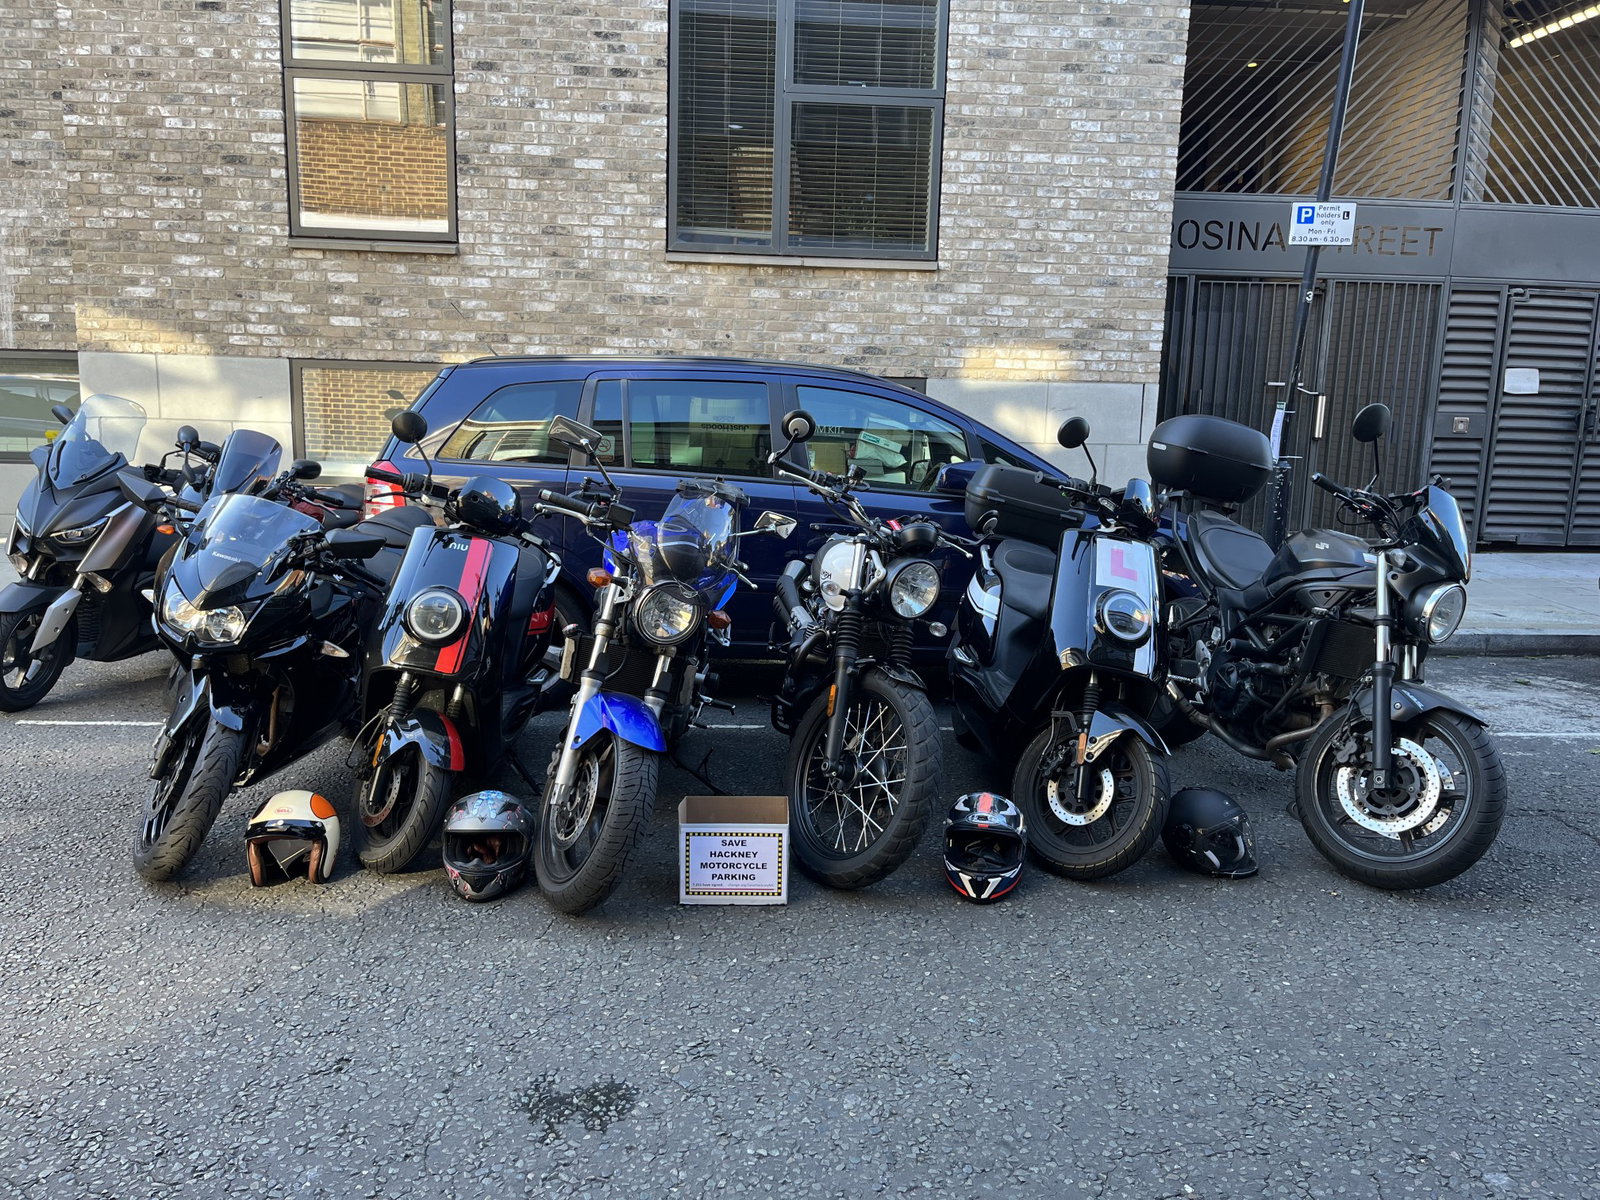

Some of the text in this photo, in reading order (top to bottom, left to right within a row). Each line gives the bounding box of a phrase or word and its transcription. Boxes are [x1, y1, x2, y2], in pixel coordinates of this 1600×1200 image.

[1171, 219, 1443, 256] OSINA REET
[1306, 291, 1313, 301] 3
[1110, 548, 1137, 582] L
[721, 839, 747, 847] SAVE
[700, 862, 768, 870] MOTORCYCLE
[711, 873, 756, 881] PARKING
